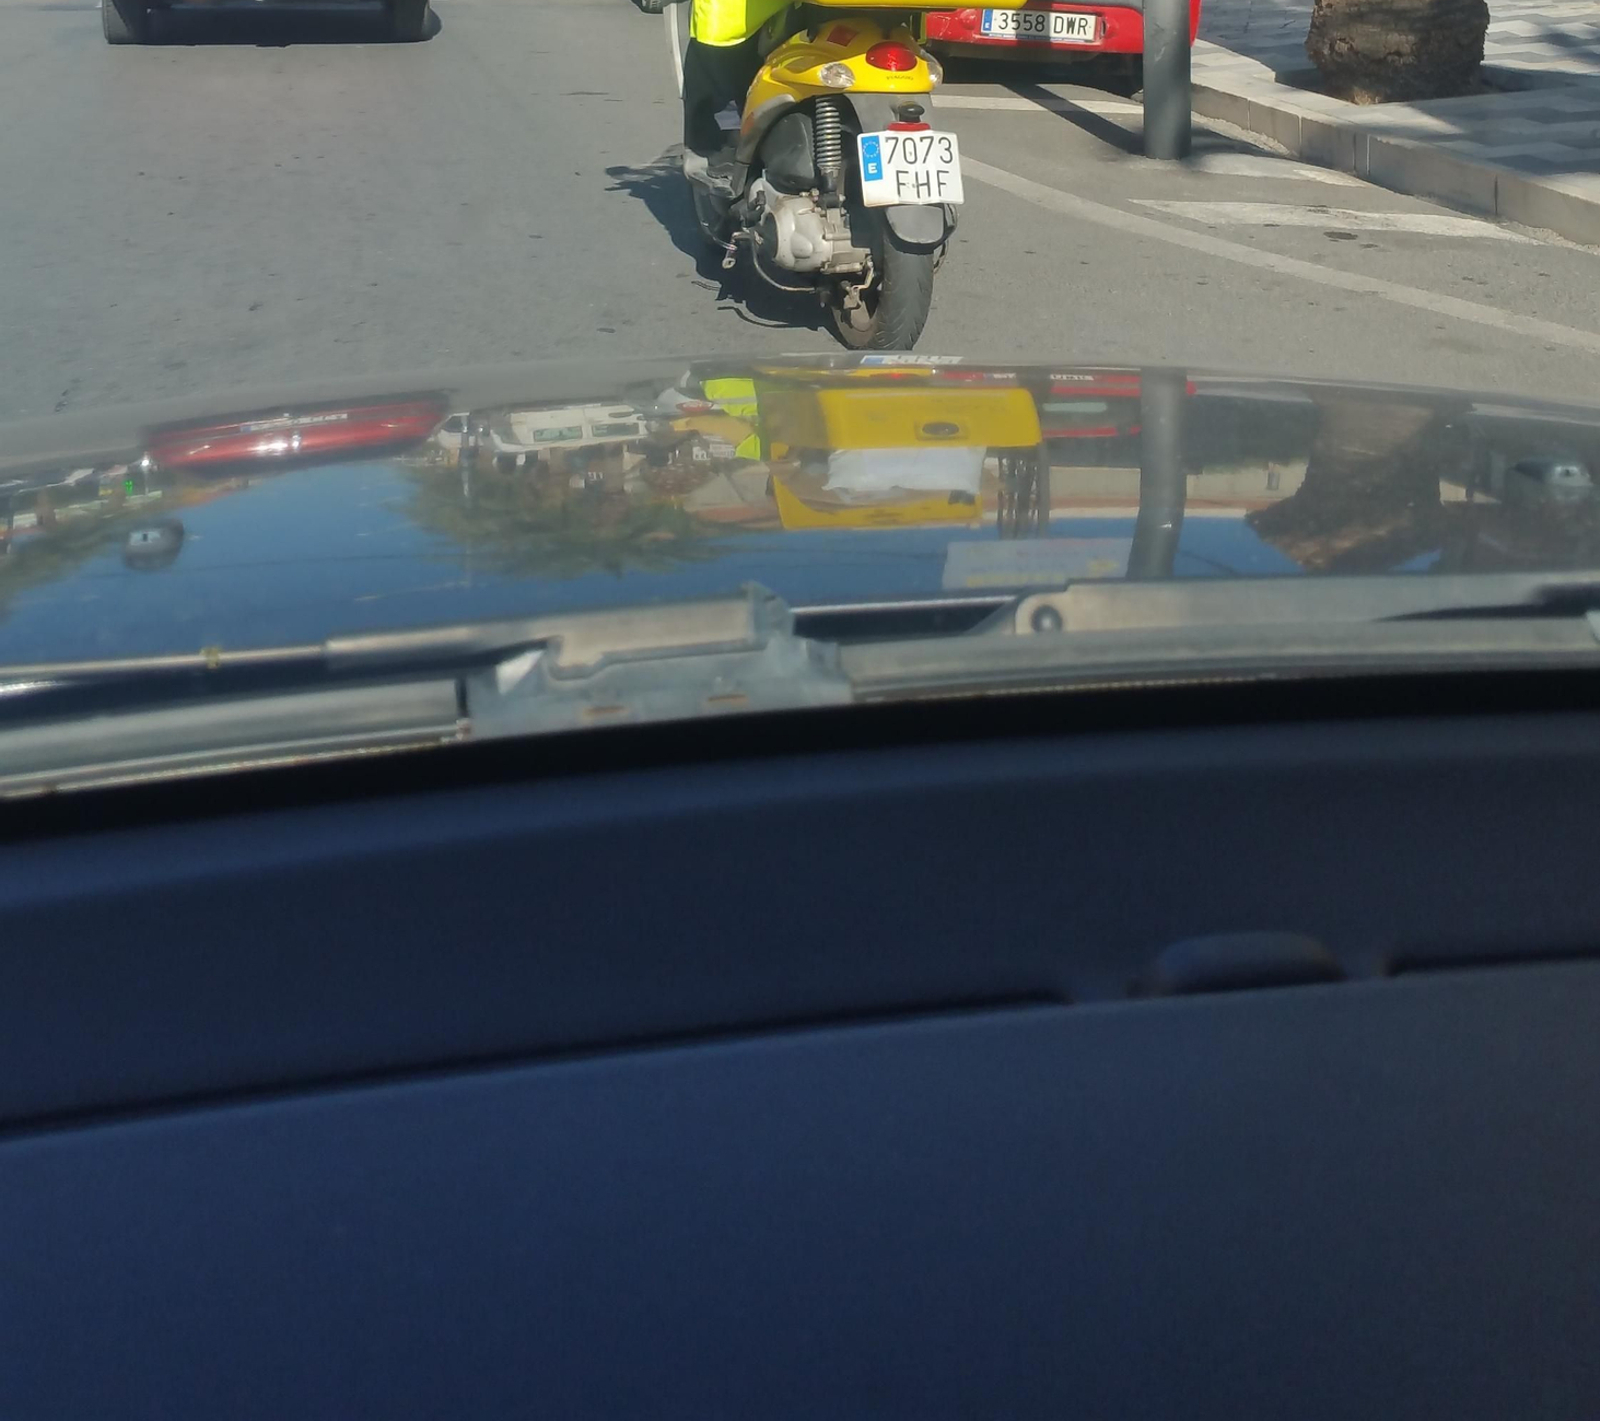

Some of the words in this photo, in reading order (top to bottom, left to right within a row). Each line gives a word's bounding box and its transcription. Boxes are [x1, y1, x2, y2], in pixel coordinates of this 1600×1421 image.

[998, 12, 1046, 33] 3558
[1053, 15, 1089, 36] DWR
[885, 136, 953, 165] 7073
[896, 170, 950, 199] FHF
